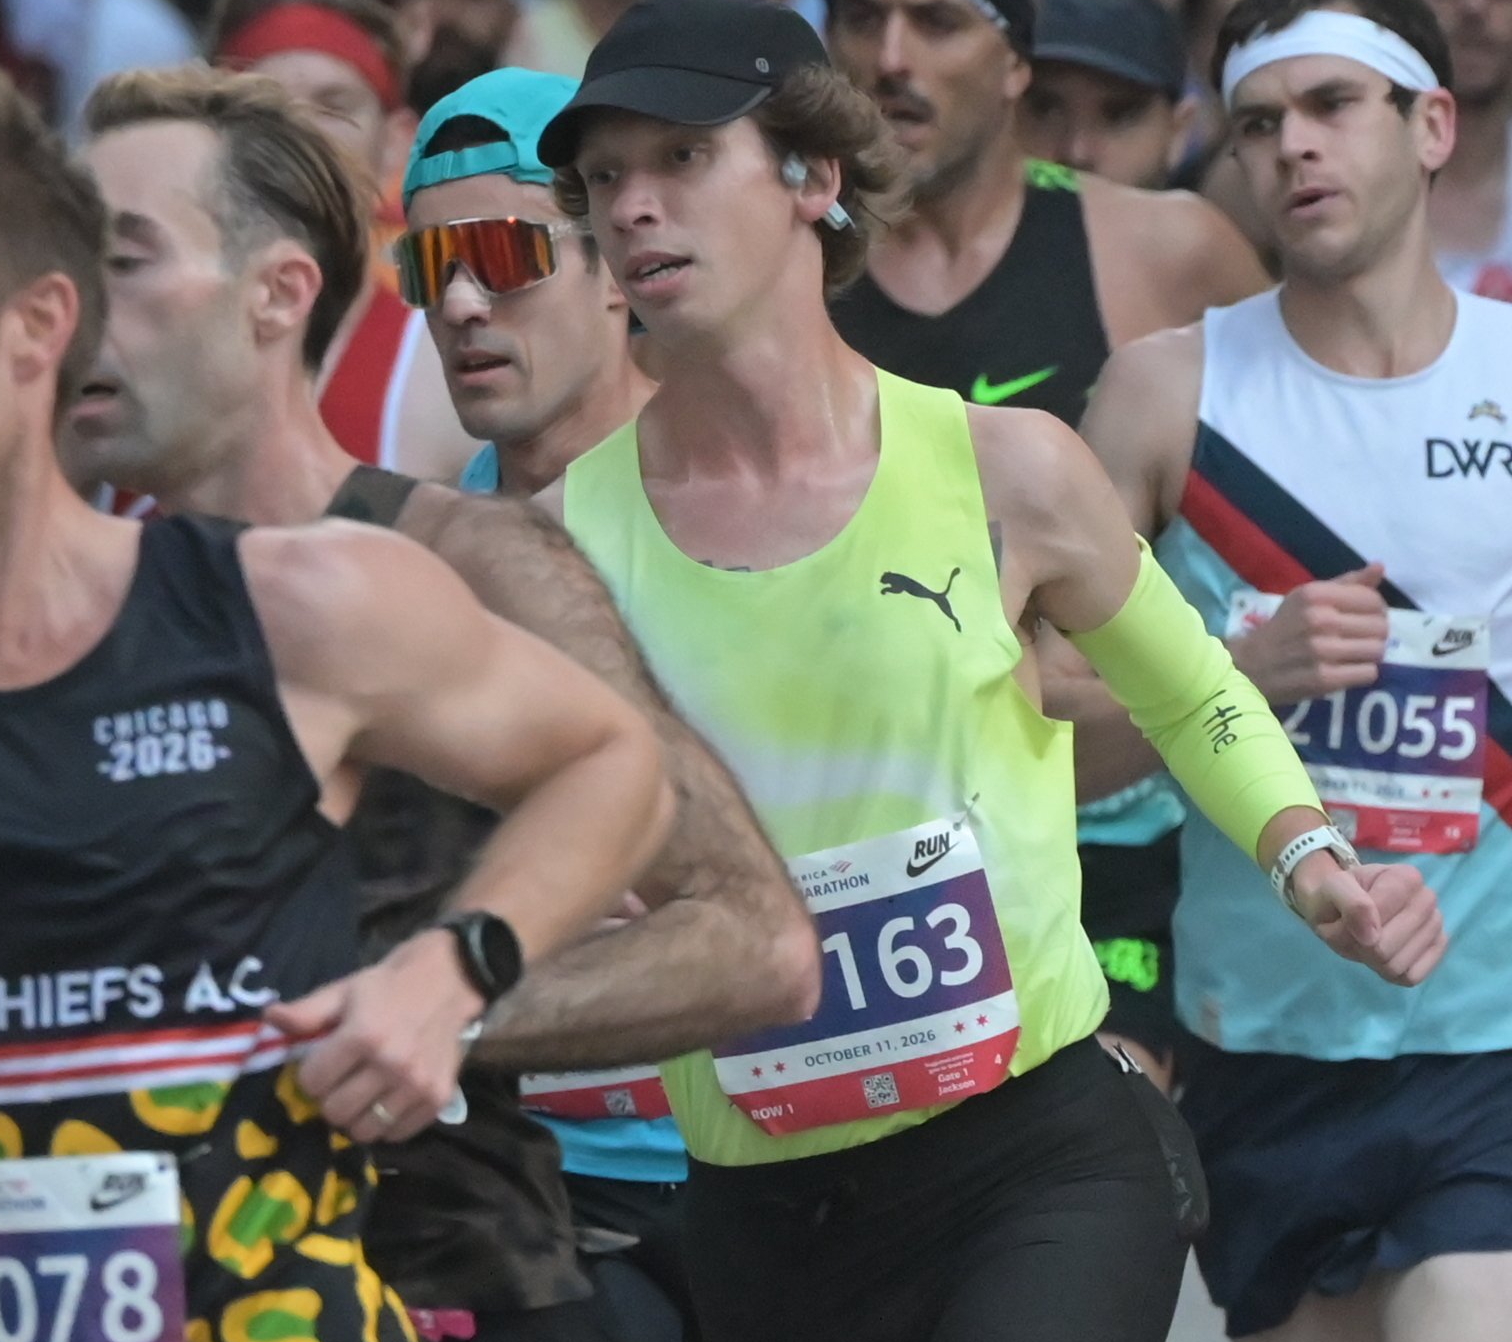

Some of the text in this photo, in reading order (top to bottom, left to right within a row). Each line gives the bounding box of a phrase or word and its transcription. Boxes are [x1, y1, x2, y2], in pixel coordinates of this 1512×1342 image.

[1284, 690, 1477, 761] 21055
[914, 831, 951, 860] RUN
[804, 872, 870, 899] ARATHON
[821, 902, 984, 1011] 163
[804, 1029, 936, 1068] OCTOBER 11, 2026
[751, 1105, 783, 1121] ROW
